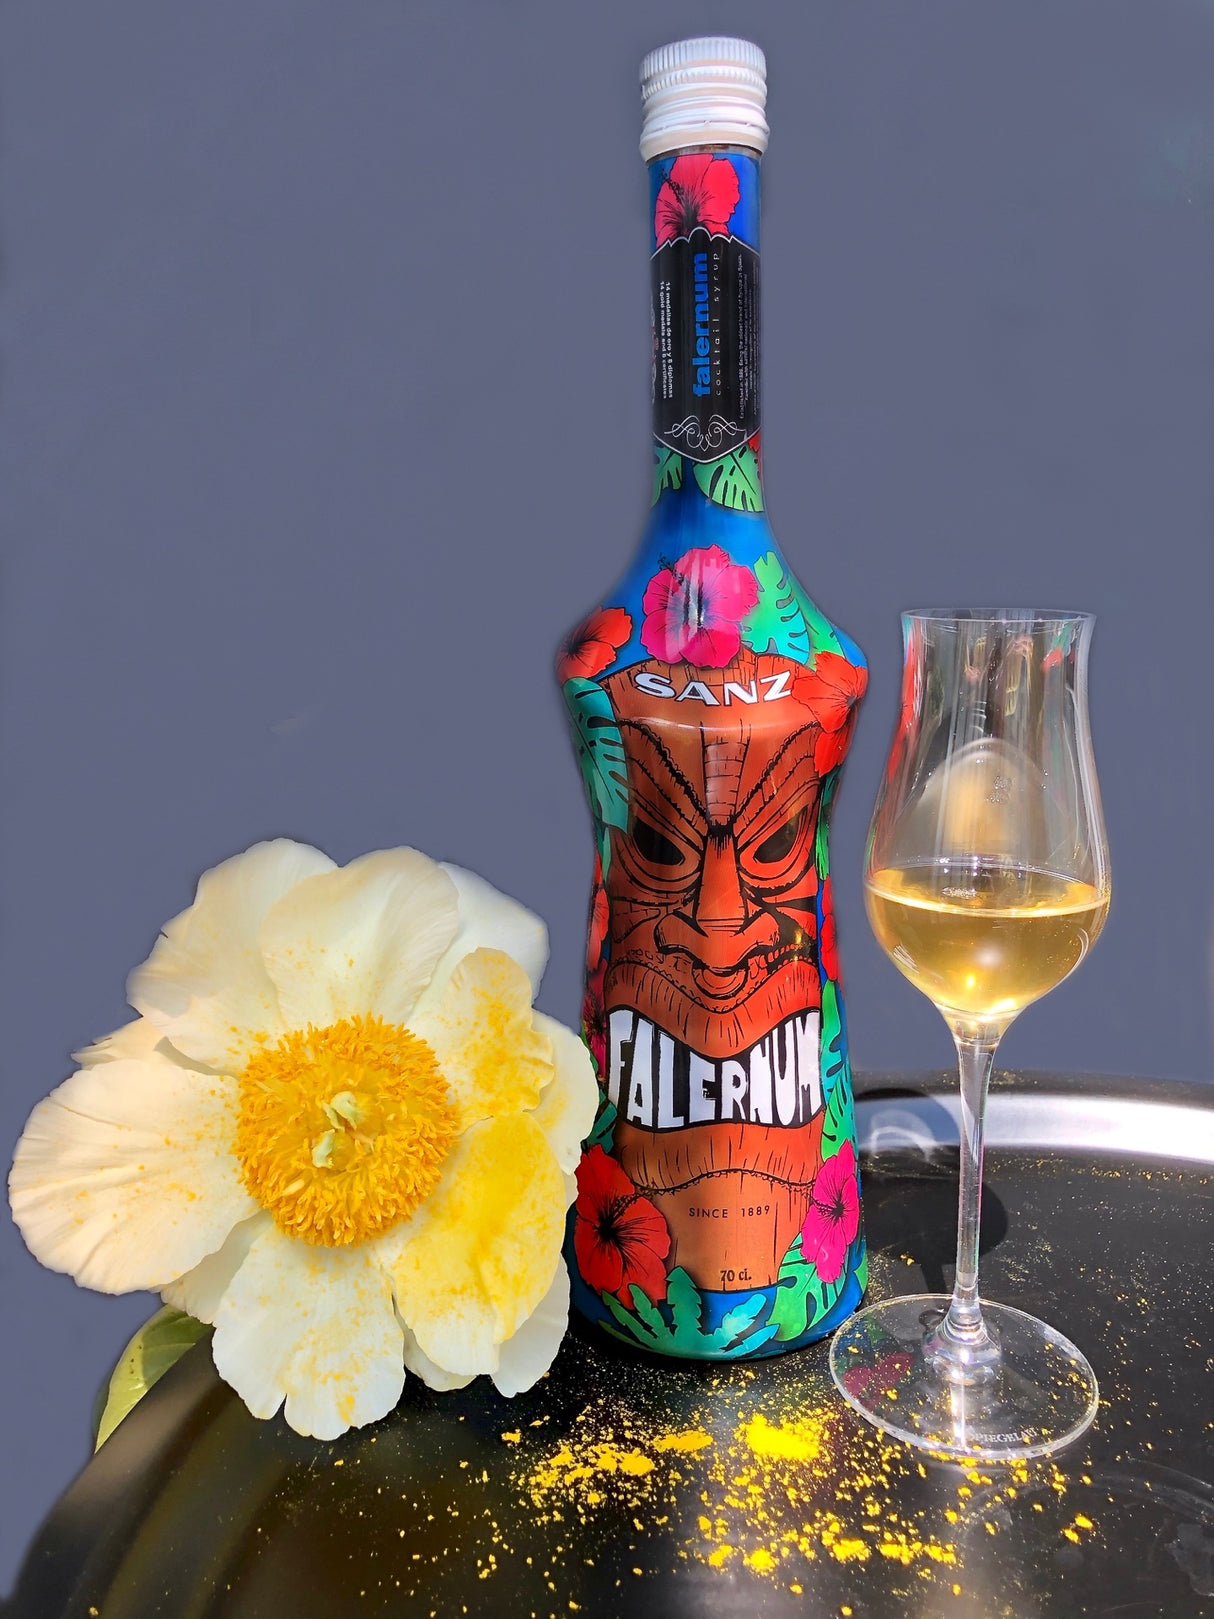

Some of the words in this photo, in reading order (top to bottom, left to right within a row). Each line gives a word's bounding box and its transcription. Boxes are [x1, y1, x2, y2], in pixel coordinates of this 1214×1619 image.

[713, 253, 721, 302] syrup
[692, 253, 711, 397] falernum
[713, 318, 721, 396] cocktail
[634, 670, 792, 706] SANZ
[608, 1009, 822, 1128] FALERNUM
[688, 1207, 728, 1218] SINCE
[741, 1205, 770, 1217] 1889
[720, 1269, 735, 1282] 70
